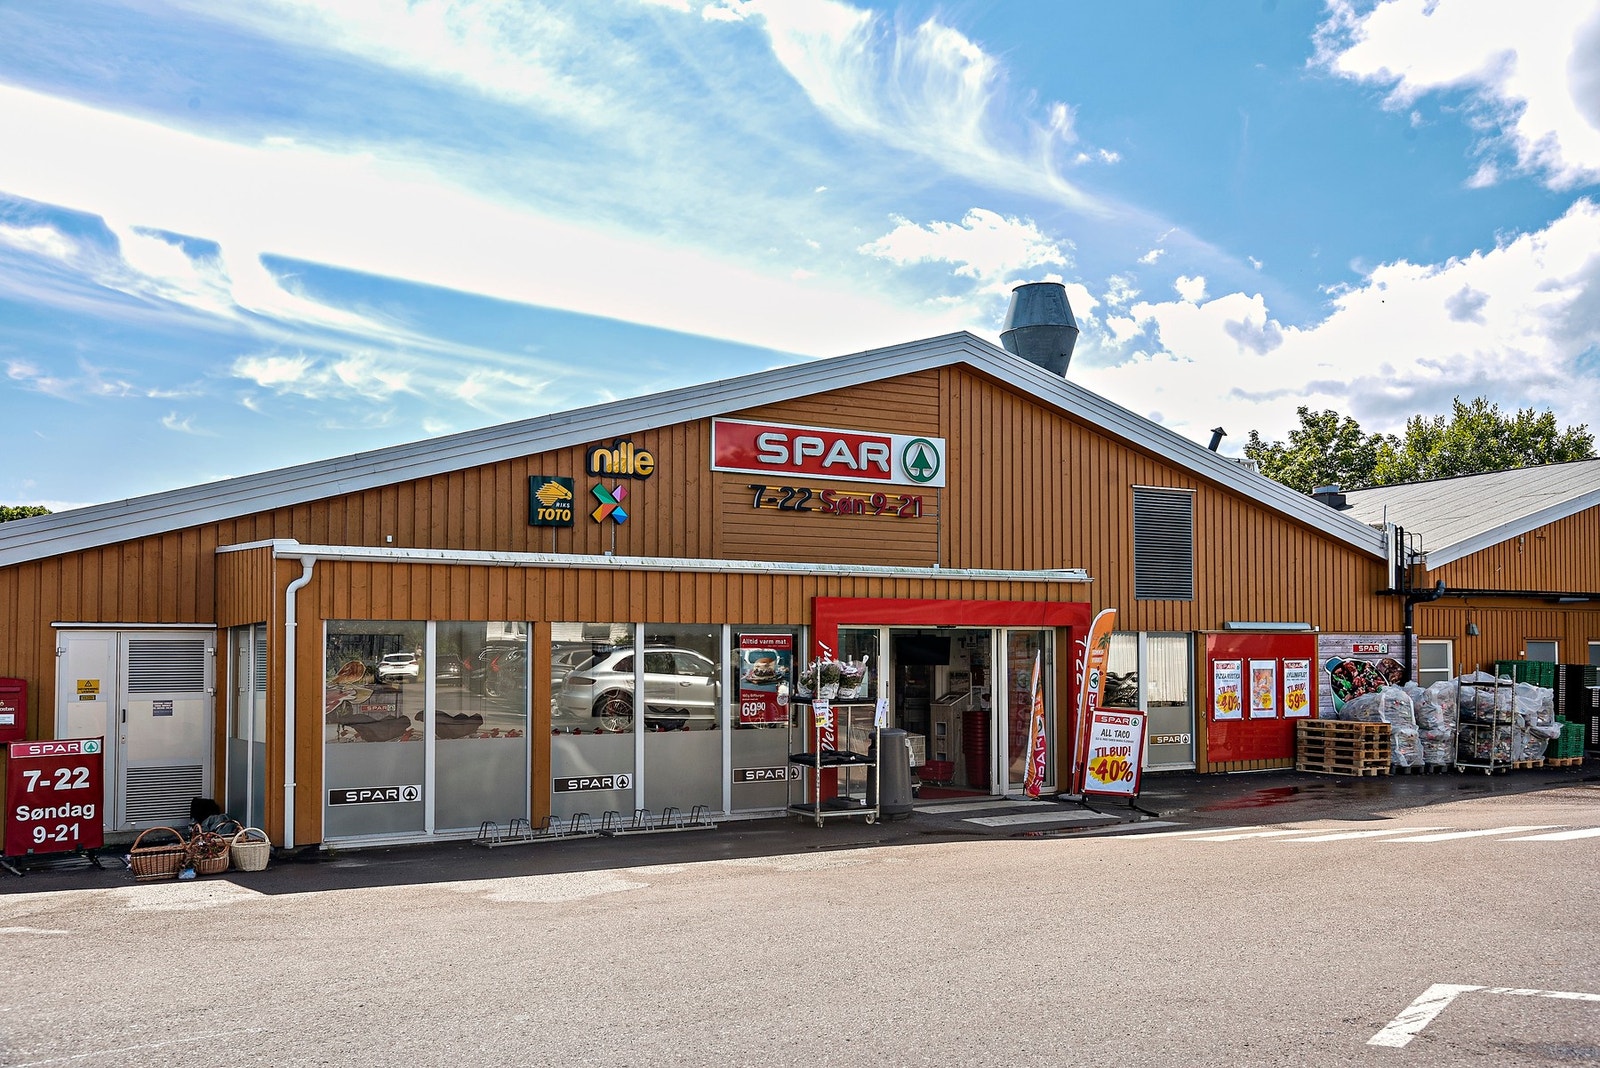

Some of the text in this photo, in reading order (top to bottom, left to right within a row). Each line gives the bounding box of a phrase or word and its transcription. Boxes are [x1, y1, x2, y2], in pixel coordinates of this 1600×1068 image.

[591, 441, 655, 476] nille
[756, 432, 890, 472] SPAR
[748, 484, 923, 518] 7-22 Søn 9-21
[537, 508, 571, 521] TOTO
[1100, 716, 1130, 725] SPAR
[1100, 728, 1130, 739] ALL TACO
[1157, 735, 1180, 744] SPAR
[29, 743, 79, 755] SPAR
[1095, 745, 1131, 758] TILBUD!
[746, 769, 785, 780] SPAR
[1088, 759, 1134, 782] -40%
[23, 766, 90, 793] 7-22
[568, 777, 612, 790] SPAR
[346, 789, 398, 802] SPAR
[16, 802, 95, 822] Søndag
[33, 823, 79, 844] 9-21
